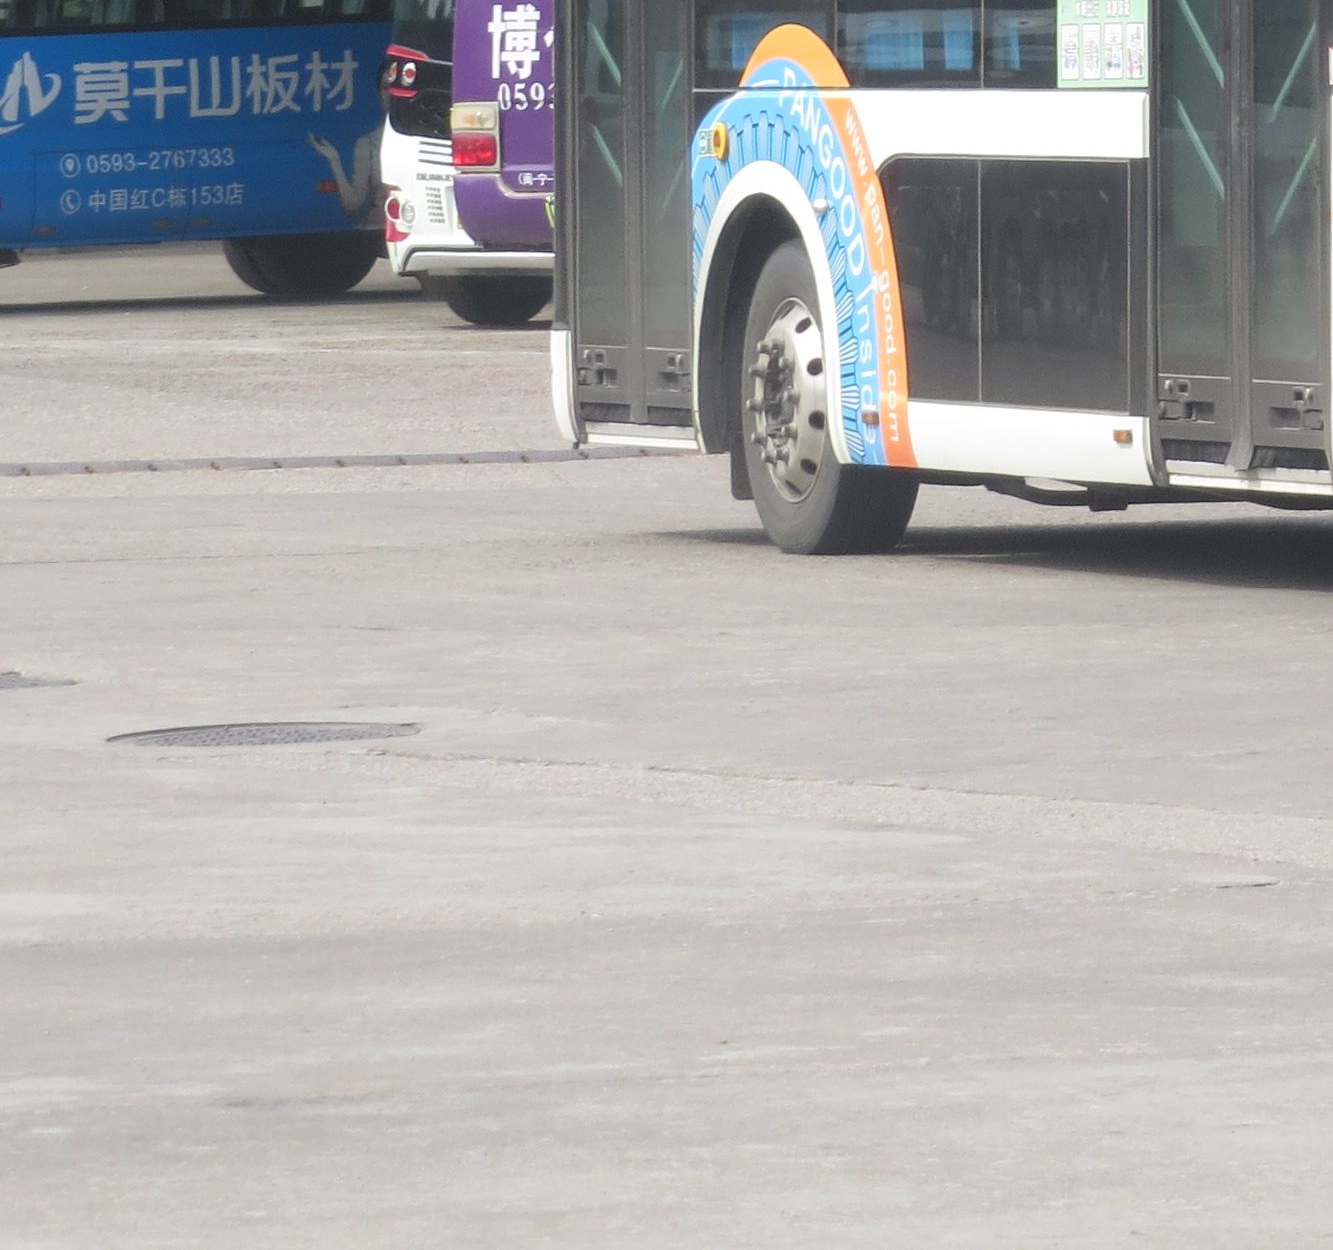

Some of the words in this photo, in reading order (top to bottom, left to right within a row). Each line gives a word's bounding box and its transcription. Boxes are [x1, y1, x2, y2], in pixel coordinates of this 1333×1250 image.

[488, 4, 554, 79] 博
[72, 50, 358, 124] 莫干山板材
[86, 148, 236, 175] 0593-2767333
[778, 66, 865, 276] PANGOOD
[845, 109, 901, 442] www.pan-good.com
